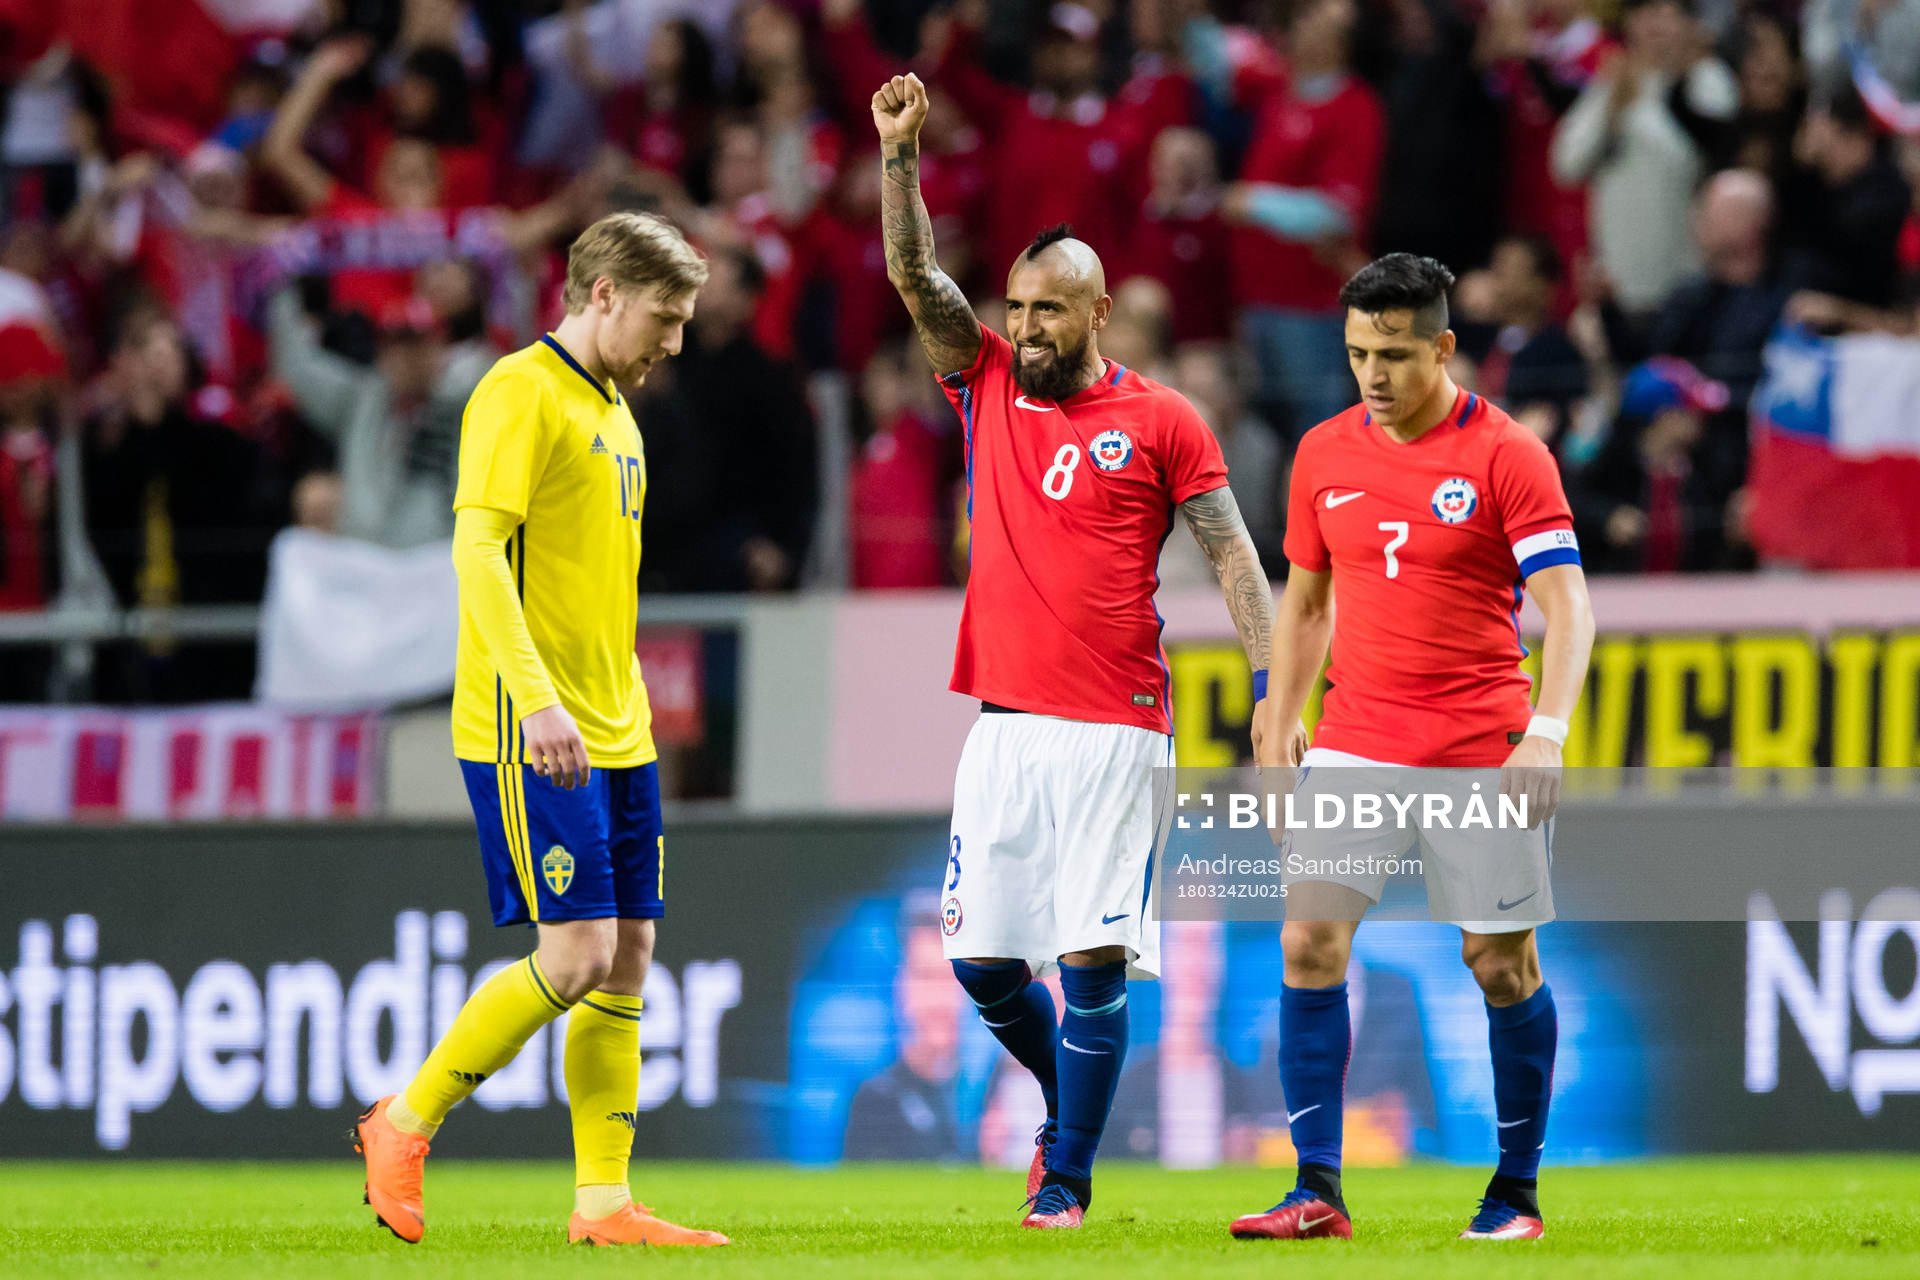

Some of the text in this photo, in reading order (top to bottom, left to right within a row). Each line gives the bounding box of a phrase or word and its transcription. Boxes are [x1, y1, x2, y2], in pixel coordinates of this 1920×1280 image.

[616, 454, 641, 520] 10
[1042, 444, 1080, 500] 8
[1378, 521, 1409, 579] 7
